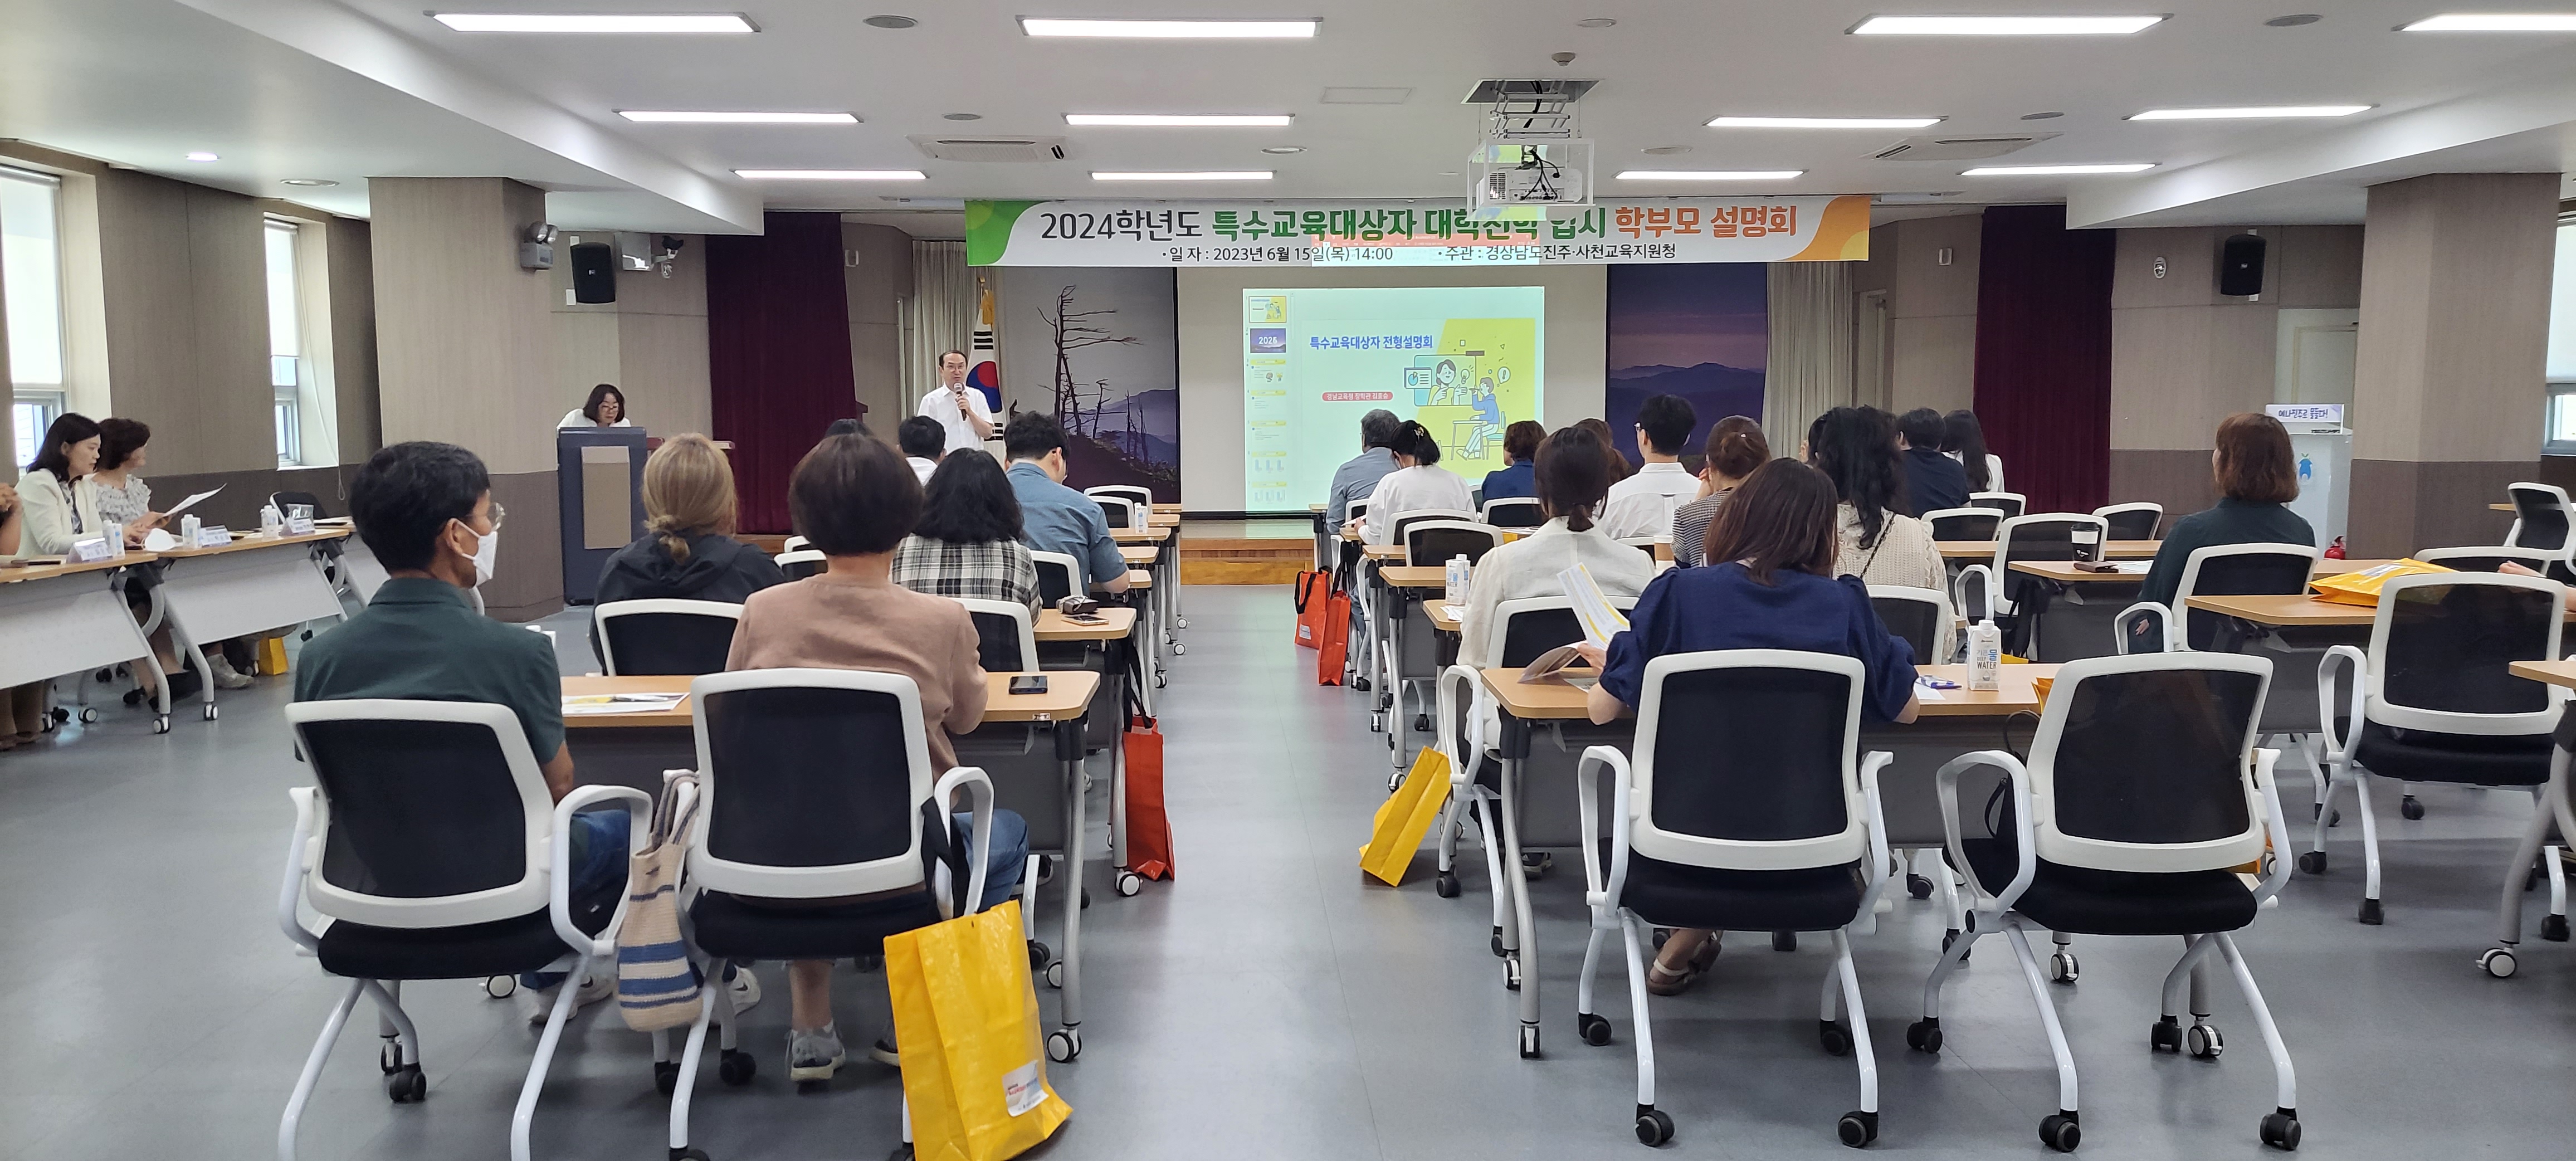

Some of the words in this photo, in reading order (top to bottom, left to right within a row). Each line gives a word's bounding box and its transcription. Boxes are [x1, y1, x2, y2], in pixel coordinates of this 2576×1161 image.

[1040, 209, 1203, 241] 2024학년도
[1212, 209, 1417, 241] 특수교육대상자
[1616, 207, 1701, 238] 학부모
[1711, 206, 1797, 238] 설명회
[1213, 247, 1263, 262] 2023년
[1267, 247, 1290, 262] 6월
[1294, 247, 1350, 262] 15일(목)
[1355, 247, 1393, 260] 14:00
[1445, 246, 1474, 261] 주관
[1310, 336, 1380, 350] 특수교육대상자
[1383, 335, 1433, 349] 전형설명회
[1977, 661, 1997, 670] WATER
